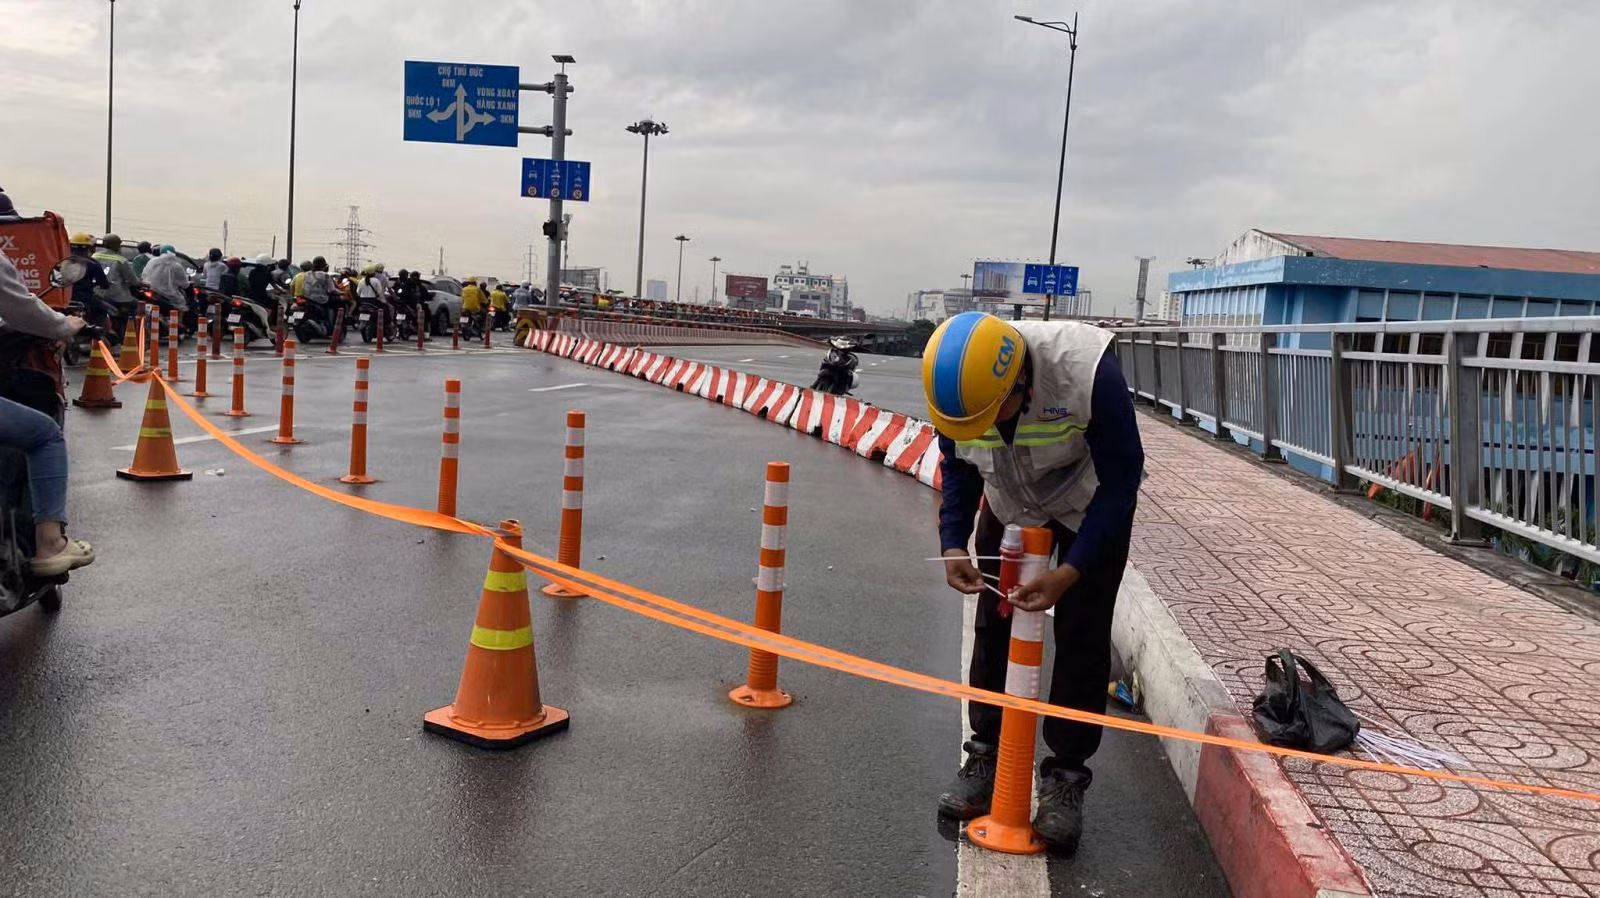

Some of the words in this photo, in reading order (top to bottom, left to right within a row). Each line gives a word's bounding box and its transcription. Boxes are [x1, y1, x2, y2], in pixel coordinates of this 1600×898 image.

[437, 66, 451, 77] CHỢ
[454, 64, 467, 76] THỦ
[406, 93, 424, 106] QUỐC
[425, 95, 435, 107] LỘ
[436, 97, 441, 107] 1
[497, 101, 516, 111] XANH
